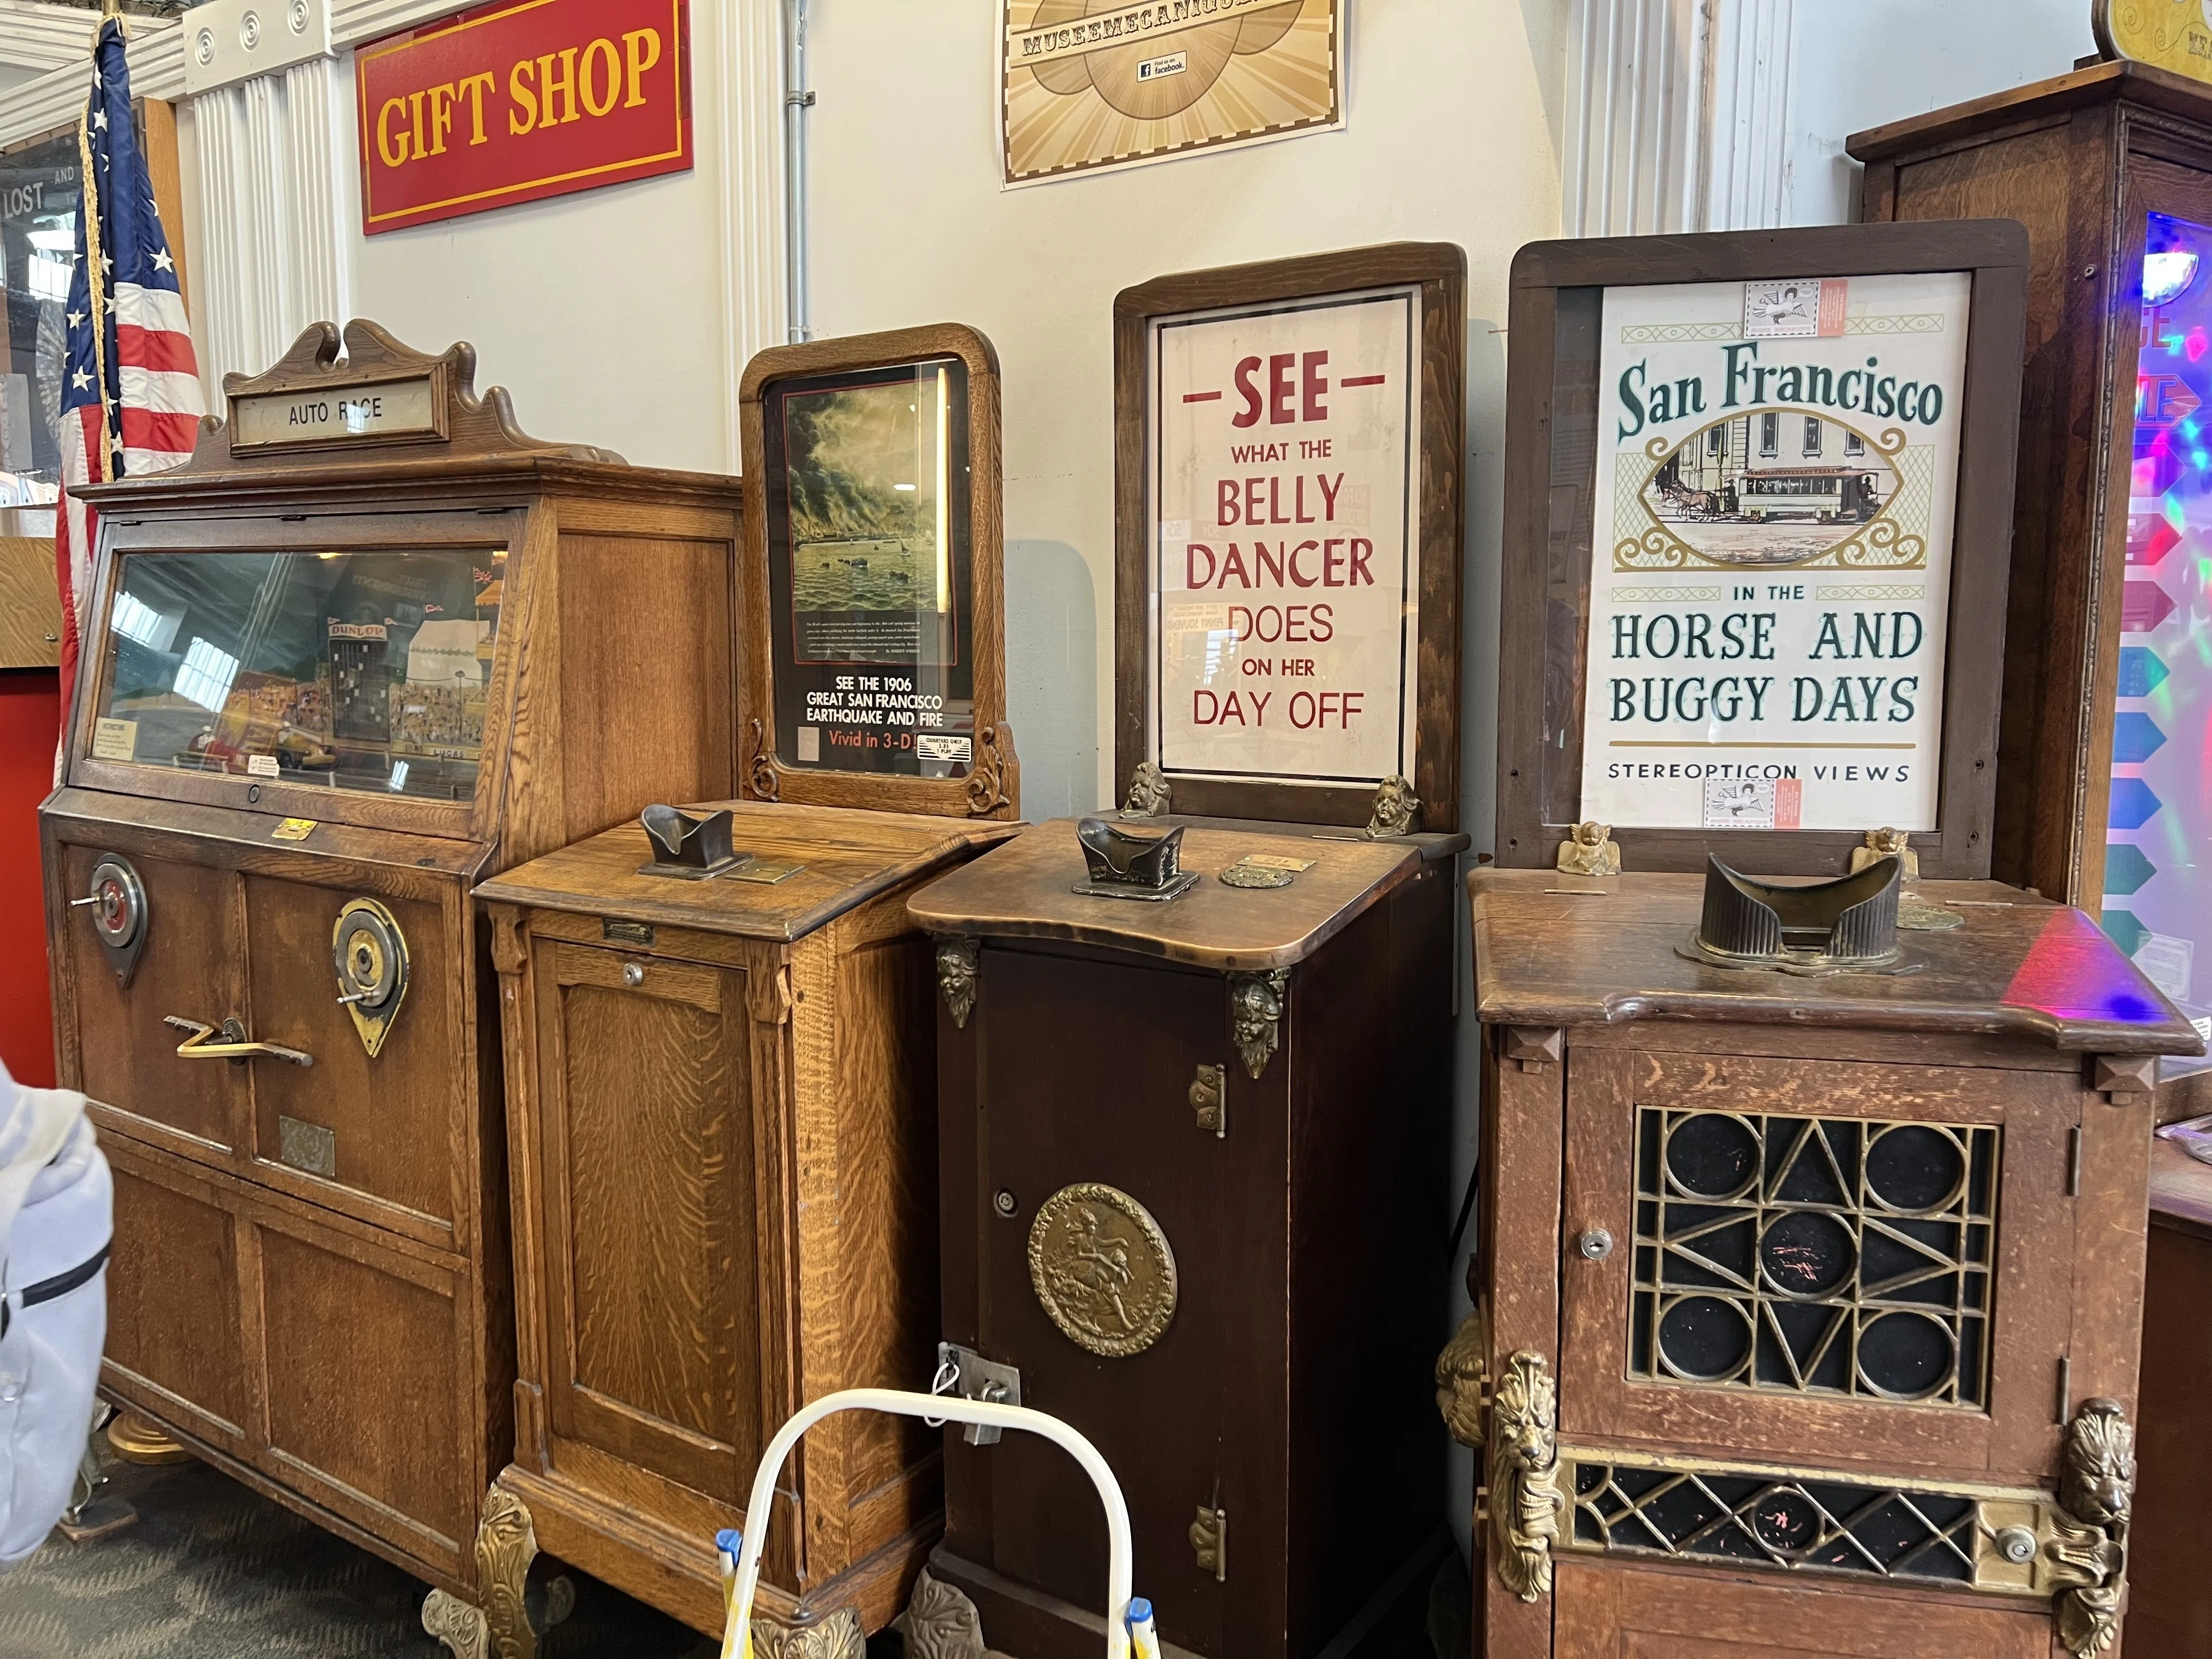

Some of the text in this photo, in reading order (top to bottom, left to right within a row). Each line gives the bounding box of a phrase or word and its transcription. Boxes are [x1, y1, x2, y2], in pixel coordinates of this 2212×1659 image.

[377, 27, 661, 167] GIFT SHOP
[4, 166, 74, 219] LOST AND
[1231, 349, 1328, 428] SEE
[1617, 341, 1943, 447] San Francisco
[289, 402, 328, 426] AUTO
[1231, 438, 1331, 464] WHAT THE
[1217, 472, 1345, 526] BELLY
[1186, 538, 1375, 589] DANCER
[1734, 585, 1804, 600] IN THE
[332, 626, 383, 636] DUNLOP
[1228, 603, 1334, 643] DOES
[1611, 611, 1923, 659] HORSE AND
[836, 675, 912, 692] SEE THE 1906
[1242, 658, 1315, 676] ON HER
[806, 691, 943, 710] GREAT SAN FRANCISCO
[1194, 690, 1364, 730] DAY OFF
[1610, 675, 1919, 723] BUGGY DAYS
[806, 708, 943, 727] EARTHQUAKE AND FIRE
[829, 730, 917, 750] Vivid in 3-D!
[1608, 763, 1909, 782] STEREOPTICON VIEWS
